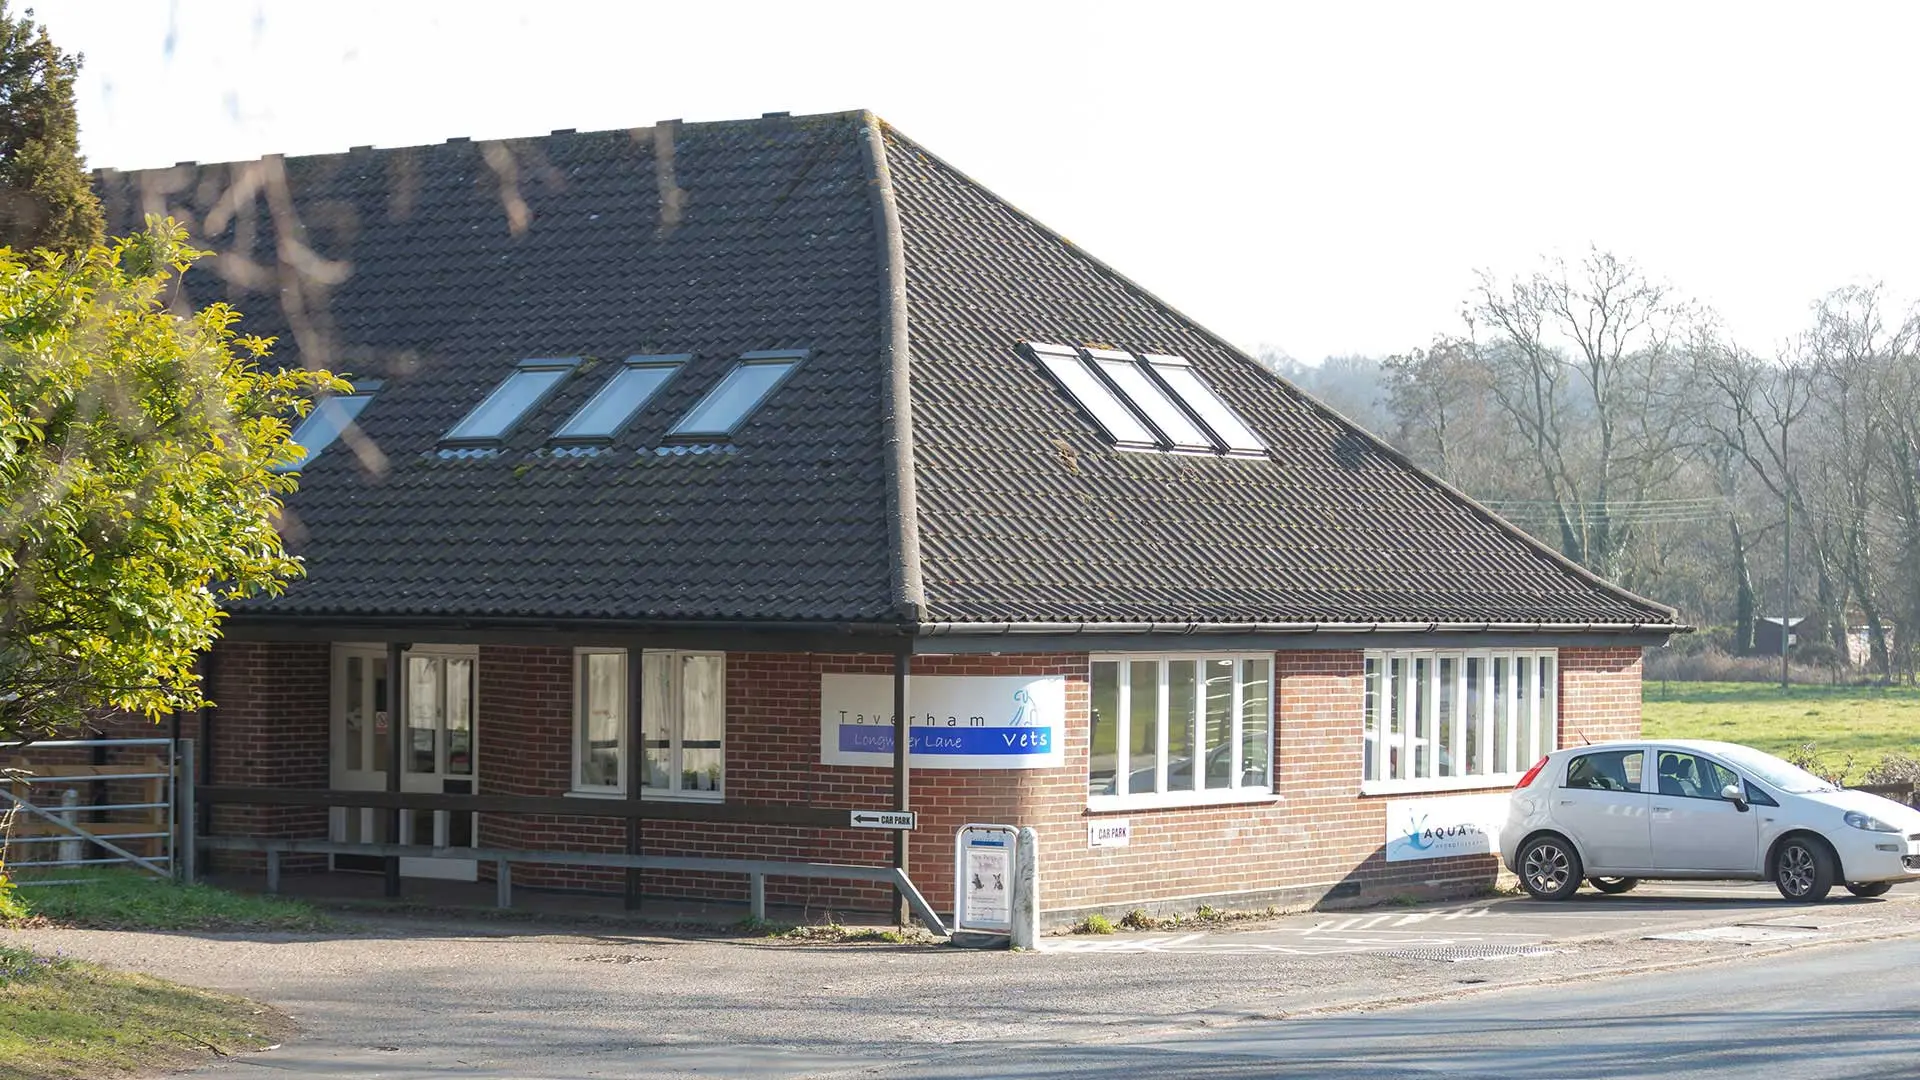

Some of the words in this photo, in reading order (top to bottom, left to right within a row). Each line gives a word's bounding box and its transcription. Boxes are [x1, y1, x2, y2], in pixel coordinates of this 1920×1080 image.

[839, 710, 985, 727] Taverham
[854, 734, 920, 750] Longwer
[925, 736, 962, 748] Lane
[1002, 731, 1048, 747] Vets
[881, 815, 894, 825] CAR
[894, 816, 911, 825] PARK
[1098, 828, 1110, 839] CAR
[1111, 827, 1127, 838] PARK
